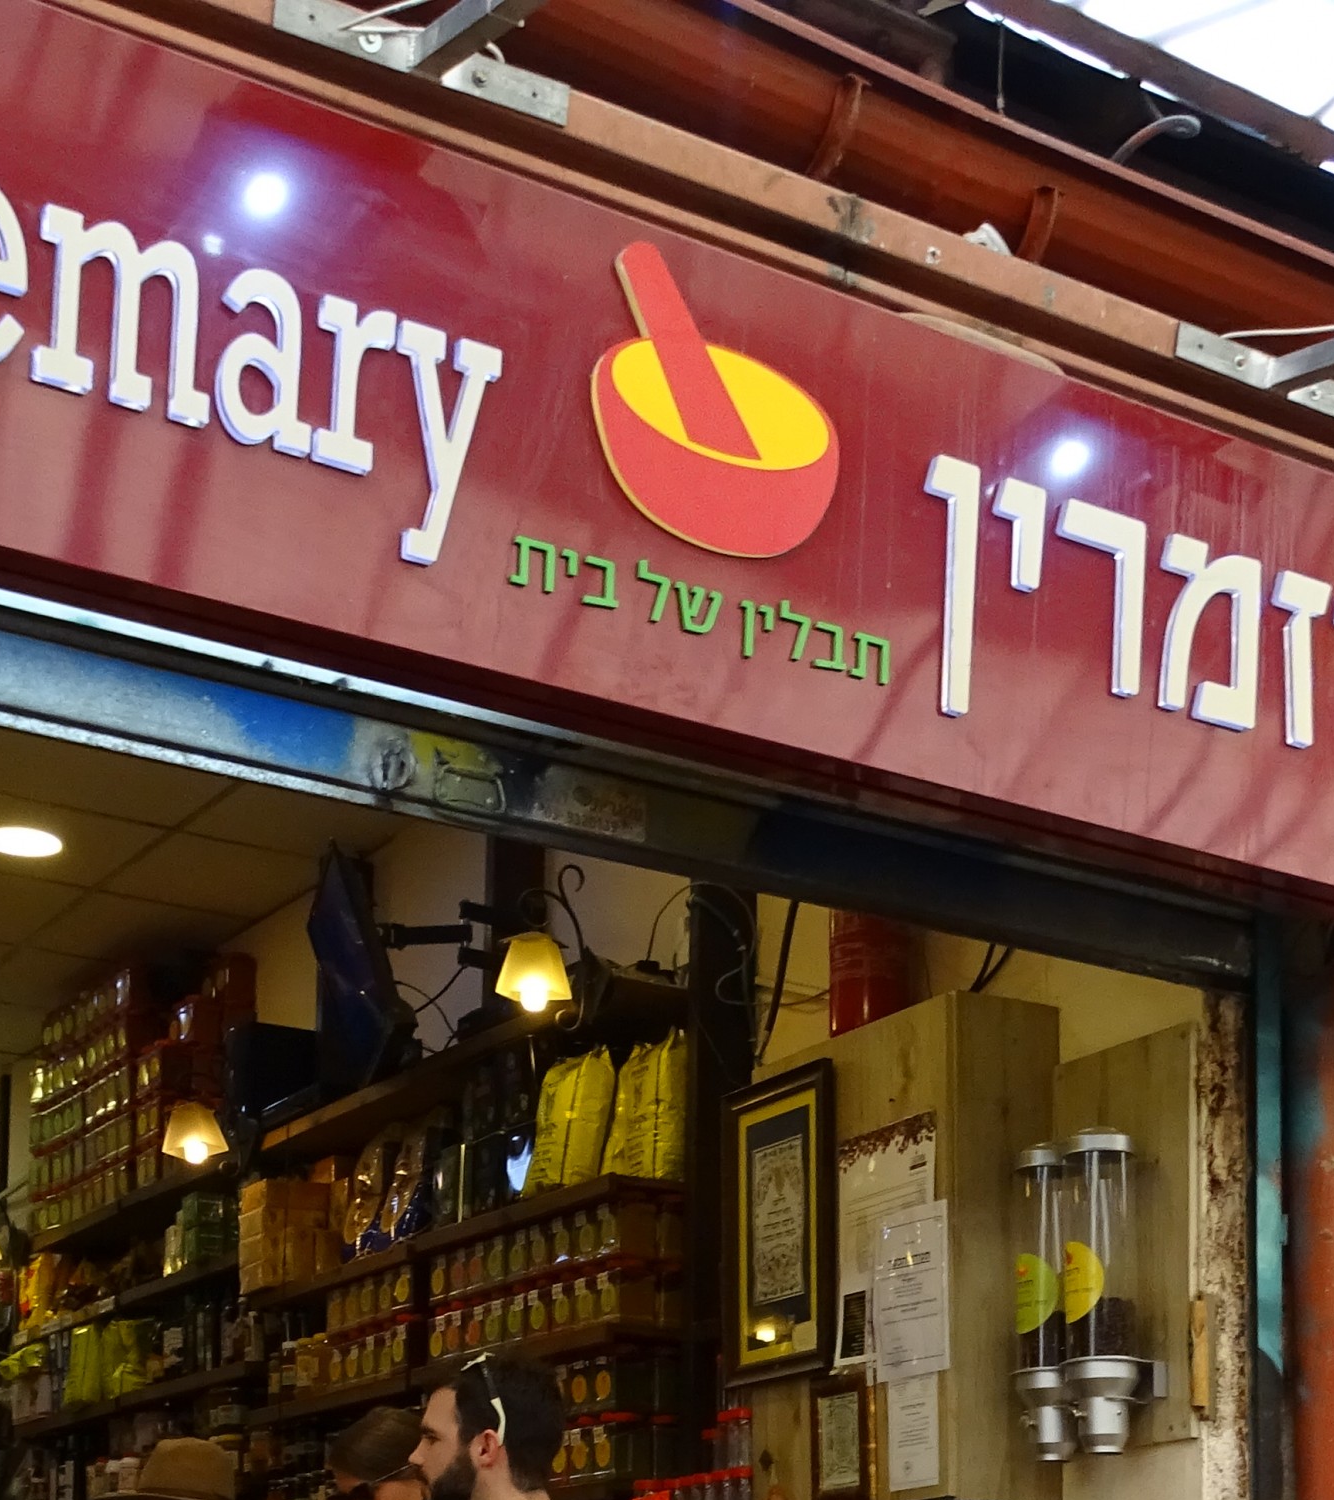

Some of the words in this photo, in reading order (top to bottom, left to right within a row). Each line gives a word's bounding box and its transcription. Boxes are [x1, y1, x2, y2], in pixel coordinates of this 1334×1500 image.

[509, 532, 621, 610] בית
[634, 558, 724, 636] של
[739, 597, 892, 686] תבלין
